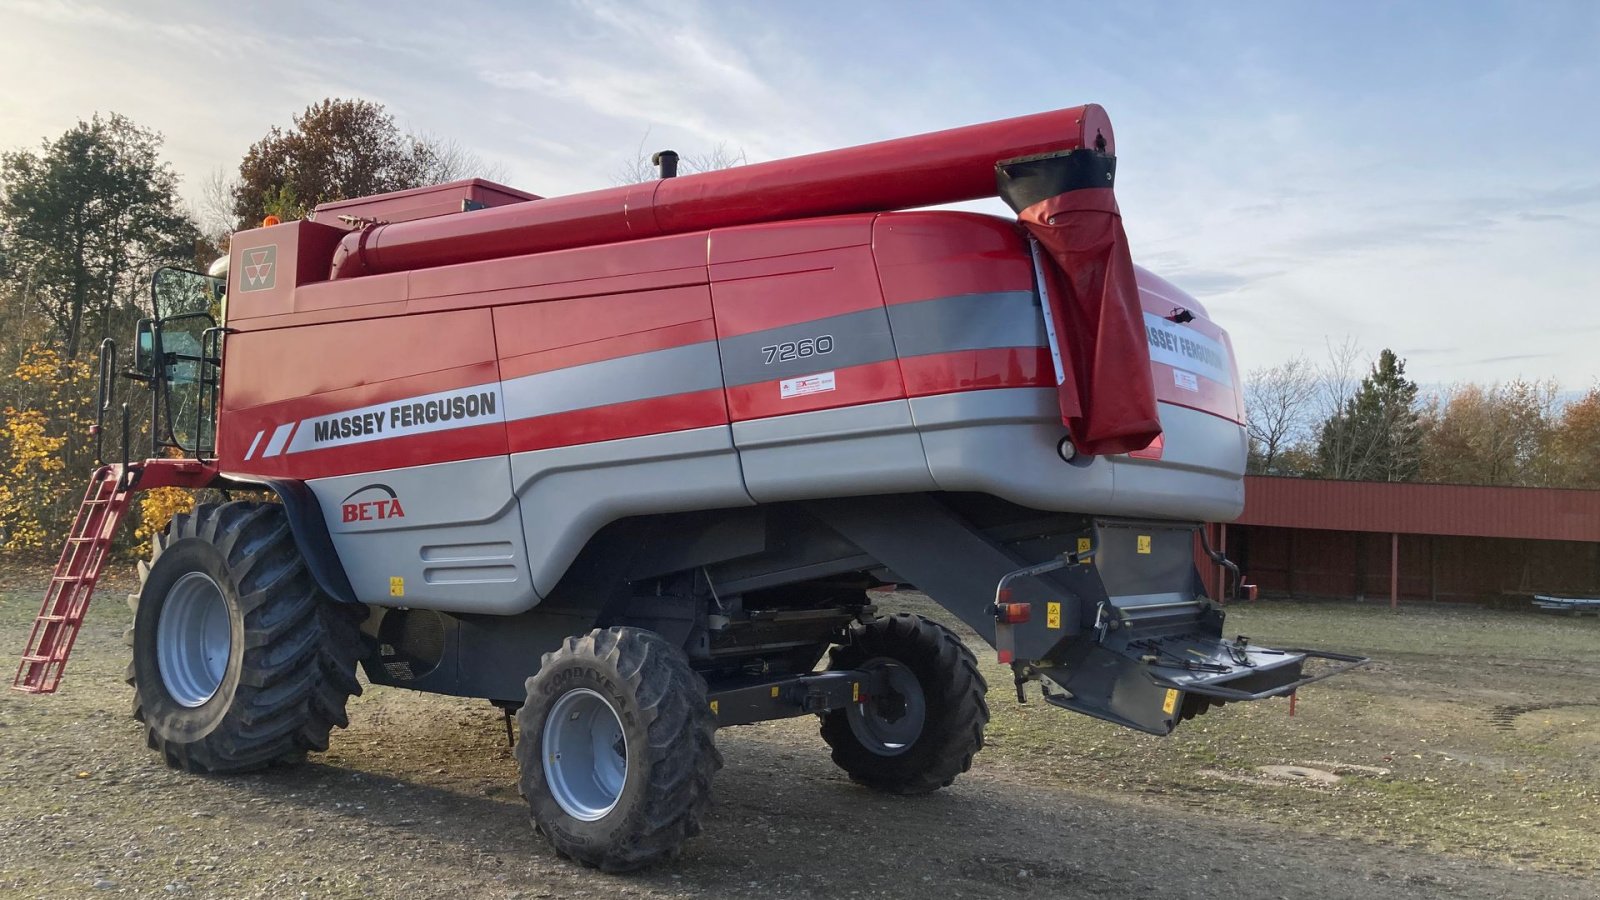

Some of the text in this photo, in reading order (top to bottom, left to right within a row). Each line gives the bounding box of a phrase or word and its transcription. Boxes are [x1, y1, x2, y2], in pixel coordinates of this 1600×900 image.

[762, 334, 834, 364] 7260
[1145, 325, 1178, 353] ASSEY
[314, 391, 496, 442] MASSEY FERGUSON
[342, 497, 405, 523] BETA
[544, 666, 636, 728] GOODYEAR
